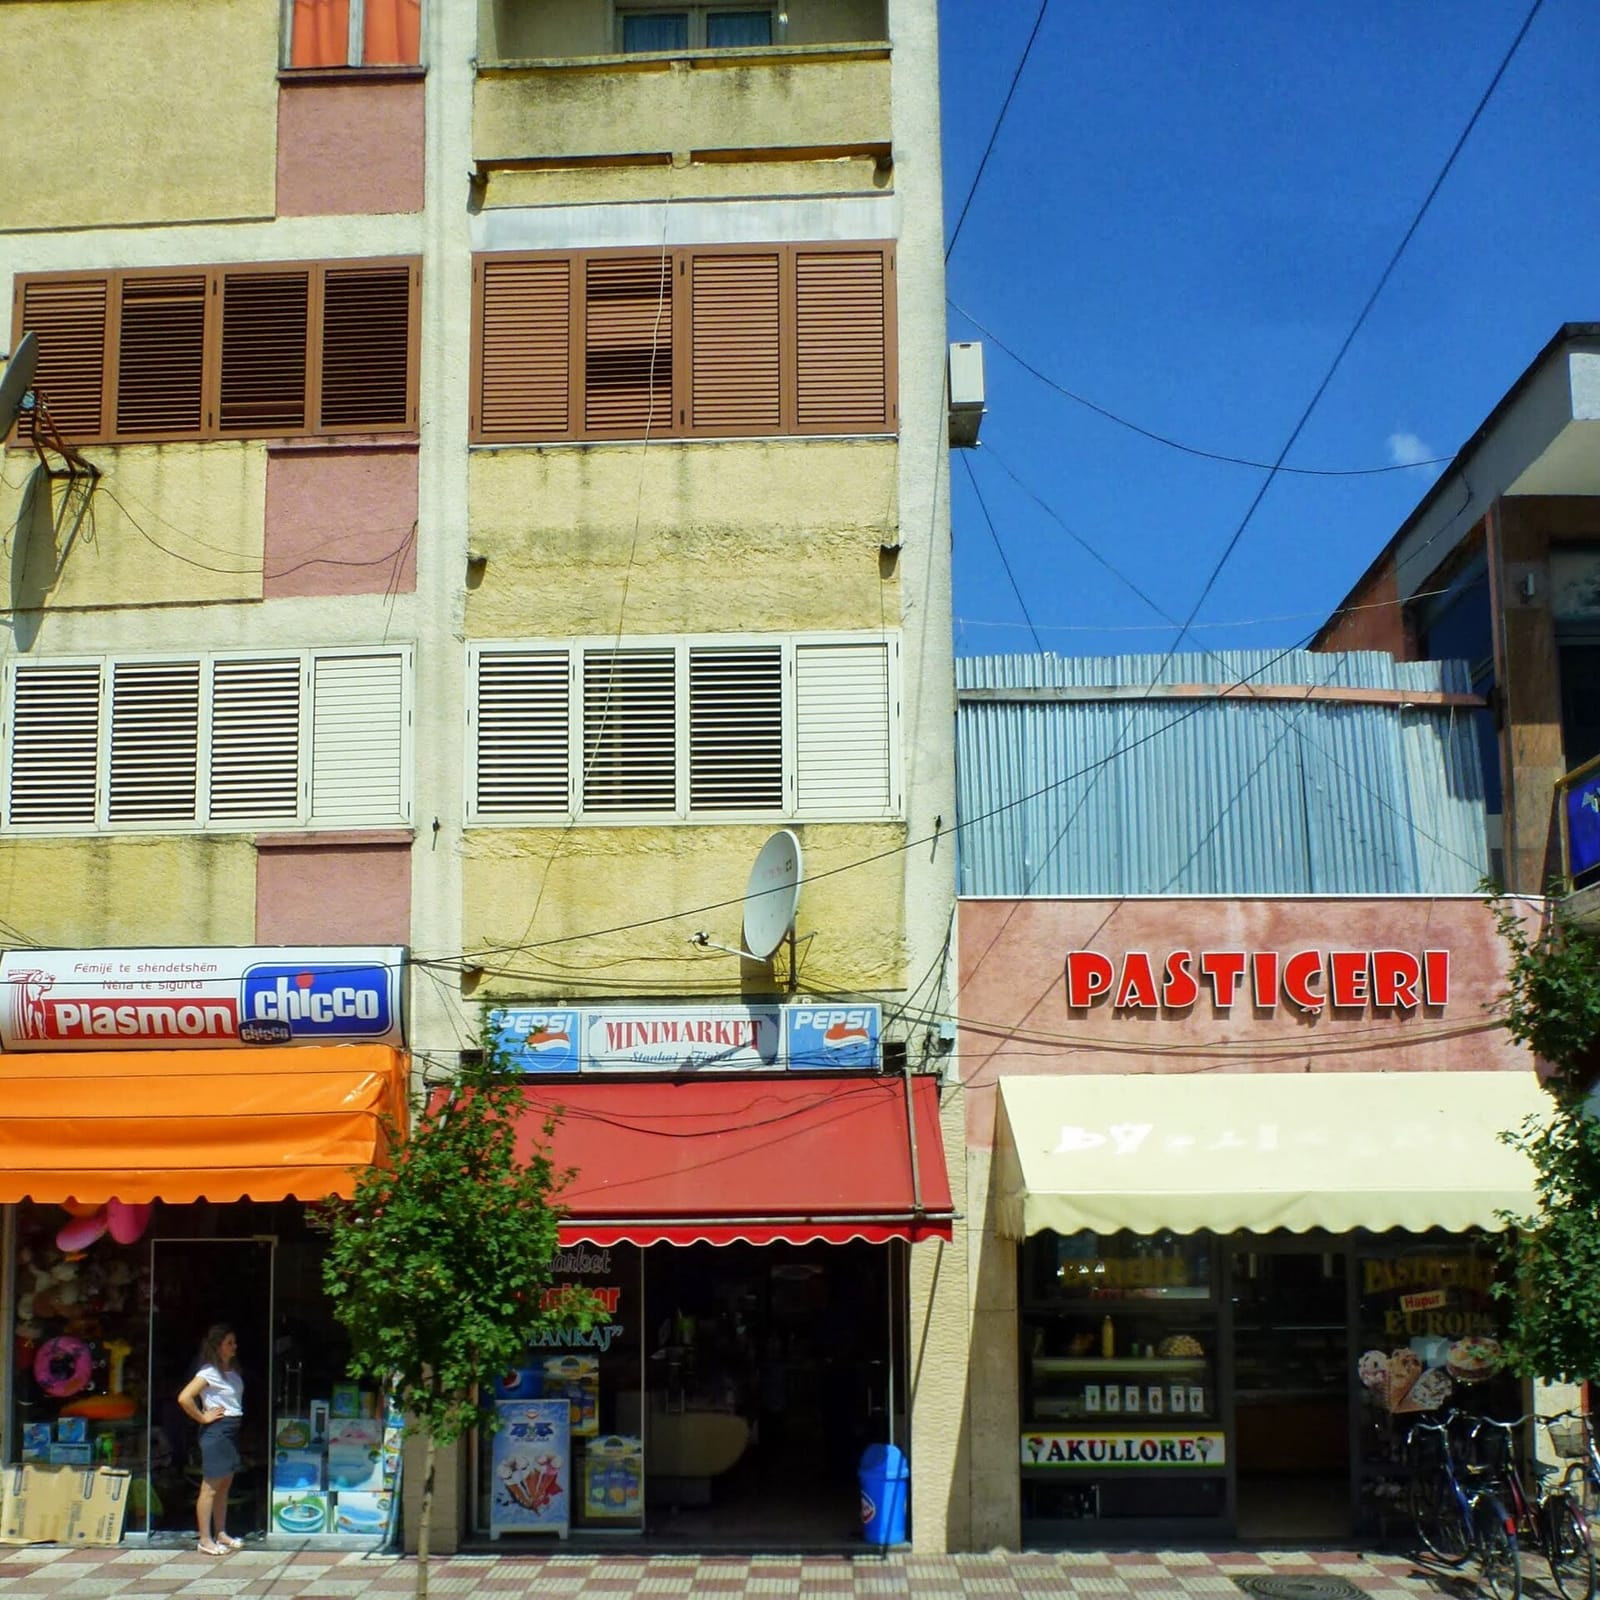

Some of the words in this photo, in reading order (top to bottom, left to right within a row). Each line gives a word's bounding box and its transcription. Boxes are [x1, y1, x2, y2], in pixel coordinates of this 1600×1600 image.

[254, 970, 379, 1022] chicco
[1067, 950, 1450, 1013] PASTIÇERI
[53, 1003, 236, 1036] Plasmon
[498, 1014, 572, 1033] PEPSI
[794, 1010, 872, 1030] PEPSI
[605, 1020, 762, 1052] MINIMARKET
[1046, 1438, 1196, 1461] AKULLORE
